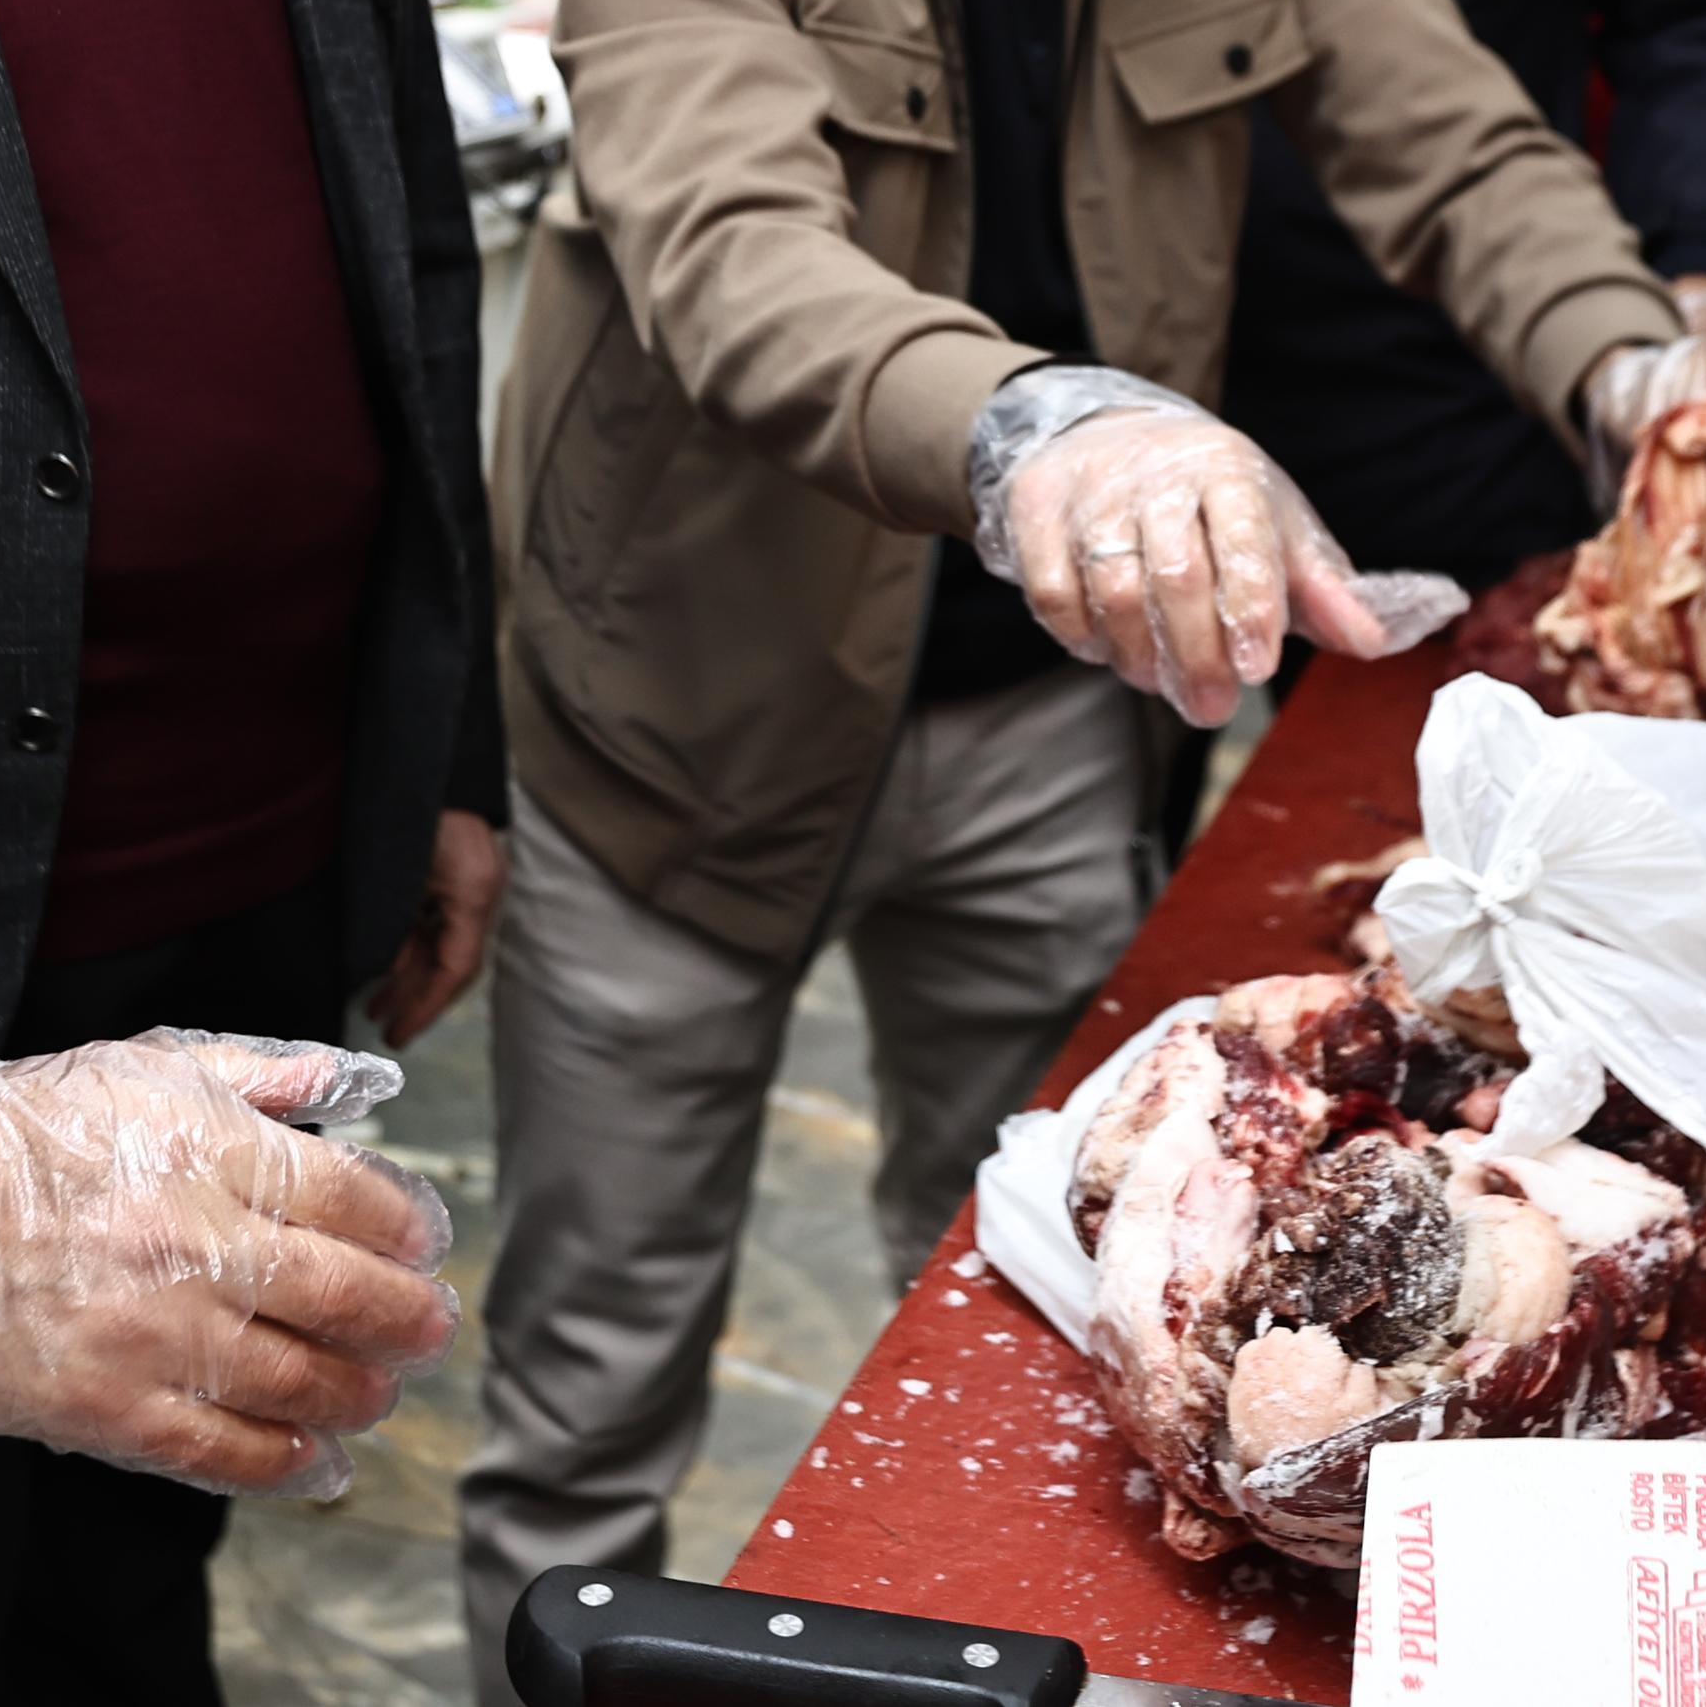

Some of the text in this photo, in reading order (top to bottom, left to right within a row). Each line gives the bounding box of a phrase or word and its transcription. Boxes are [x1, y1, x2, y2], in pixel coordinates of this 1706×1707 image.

[1631, 1472, 1654, 1531] ROSTO
[1662, 1472, 1687, 1534] BİFTEK
[1637, 1562, 1668, 1671] AFİYET
